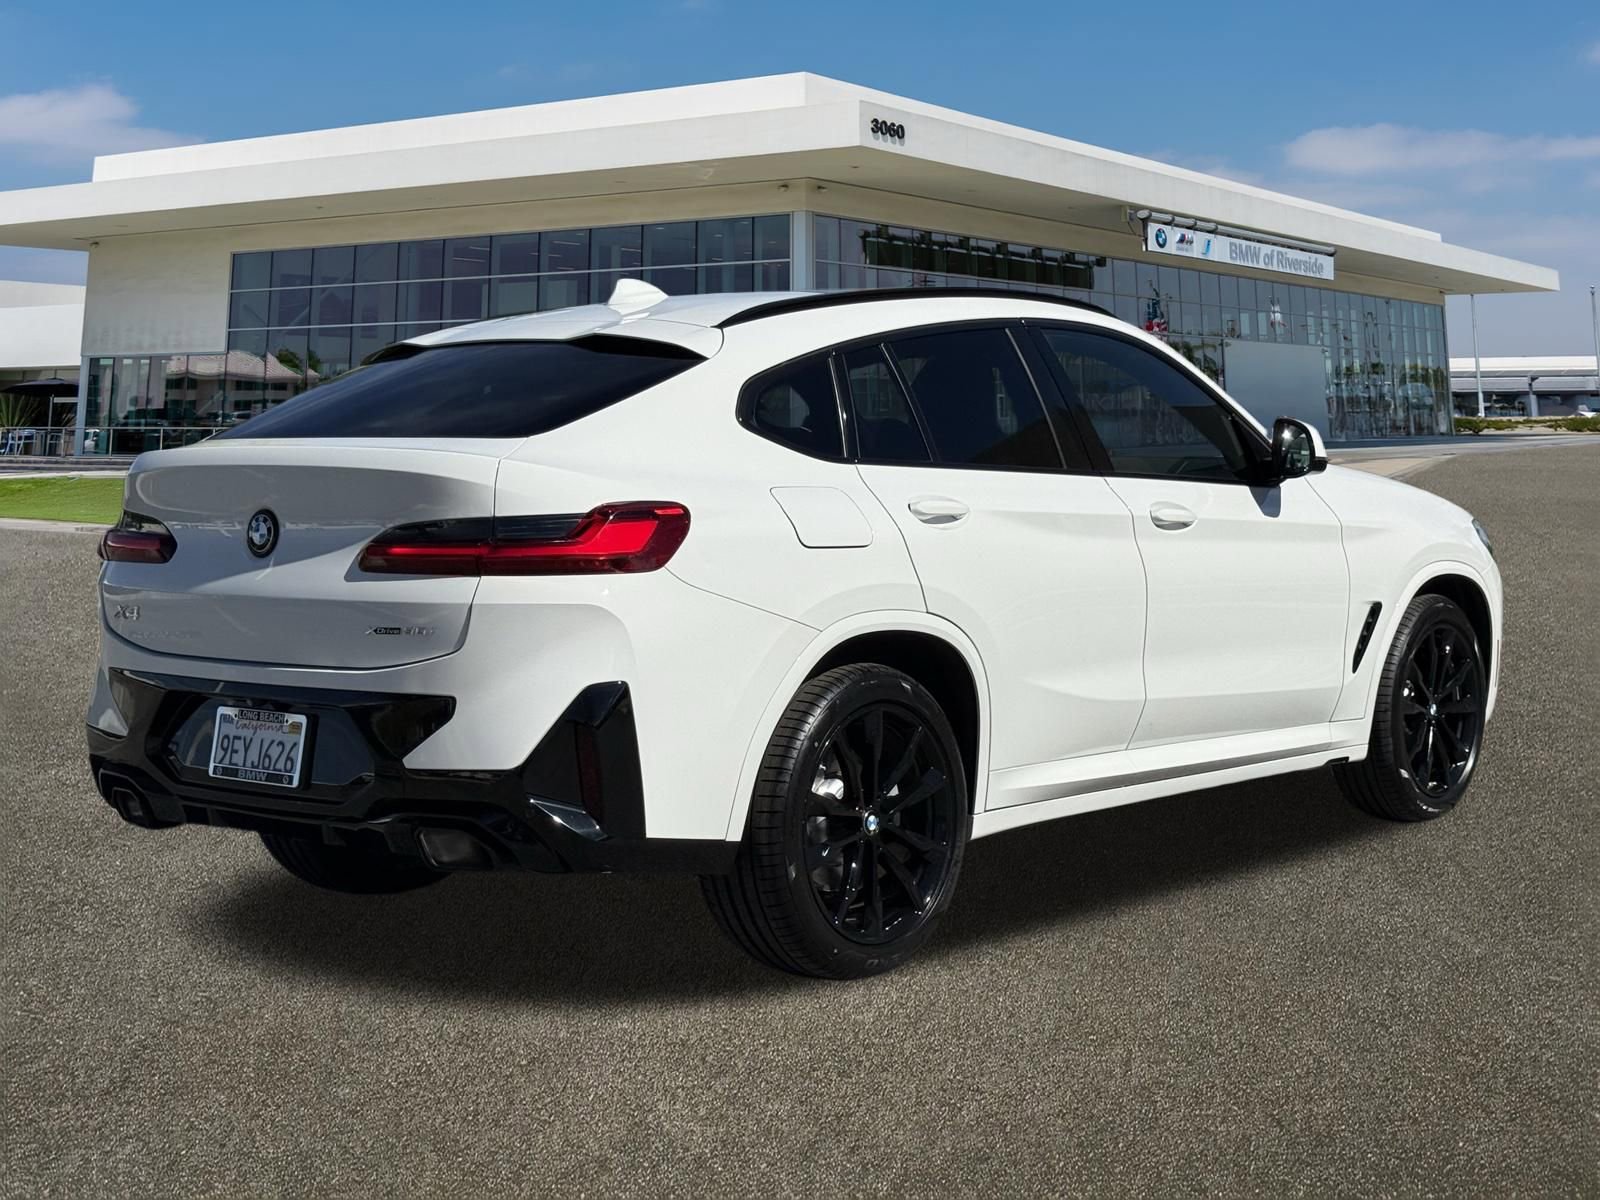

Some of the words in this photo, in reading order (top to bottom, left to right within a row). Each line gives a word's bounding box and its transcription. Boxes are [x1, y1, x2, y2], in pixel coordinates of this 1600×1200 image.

[871, 118, 905, 139] 3060
[1229, 241, 1261, 265] BMW
[1263, 249, 1275, 267] of
[1276, 251, 1325, 275] Riverside
[114, 605, 140, 620] X4
[238, 710, 259, 720] LONG
[259, 712, 285, 723] BEACH
[217, 734, 298, 772] 9EYJ626
[238, 769, 267, 782] BMW
